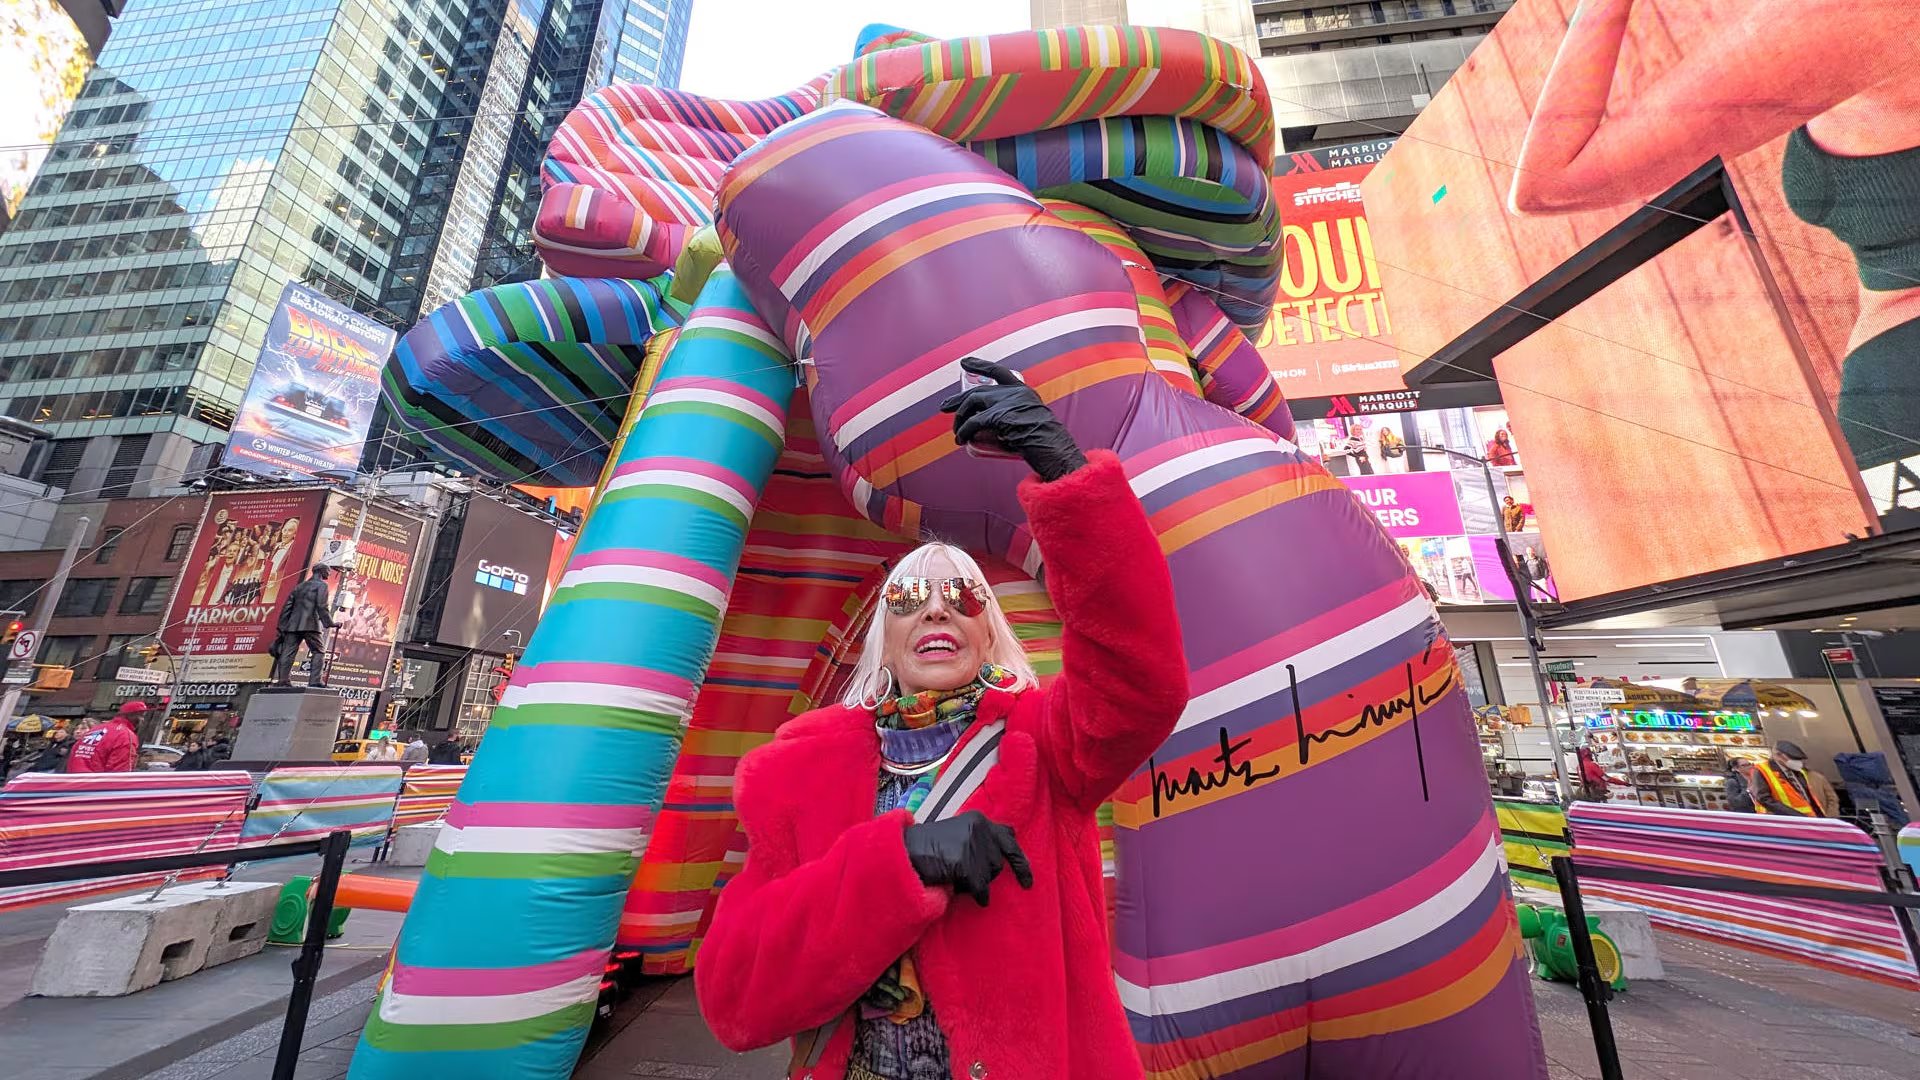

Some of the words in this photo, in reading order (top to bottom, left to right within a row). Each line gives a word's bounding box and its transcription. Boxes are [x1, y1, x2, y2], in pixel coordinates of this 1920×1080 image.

[1294, 188, 1361, 206] STITCHE
[290, 296, 344, 326] BROADWAY
[292, 290, 311, 303] IT'S
[313, 299, 335, 314] TIME
[337, 311, 349, 321] TO
[351, 318, 387, 337] CHANGE
[287, 305, 380, 364] BACK
[1359, 391, 1421, 402] MARRIOTT
[1361, 400, 1416, 411] MARQUIS
[268, 444, 290, 456] WINTER
[291, 451, 313, 464] GARDEN
[313, 459, 335, 470] THEATRE
[1372, 508, 1420, 527] ERS
[378, 560, 406, 585] NOISE
[478, 559, 529, 584] GoPro
[184, 606, 275, 625] HARMONY
[1547, 662, 1573, 671] Broadway
[115, 685, 157, 696] GIFTS
[1671, 714, 1703, 728] Dog
